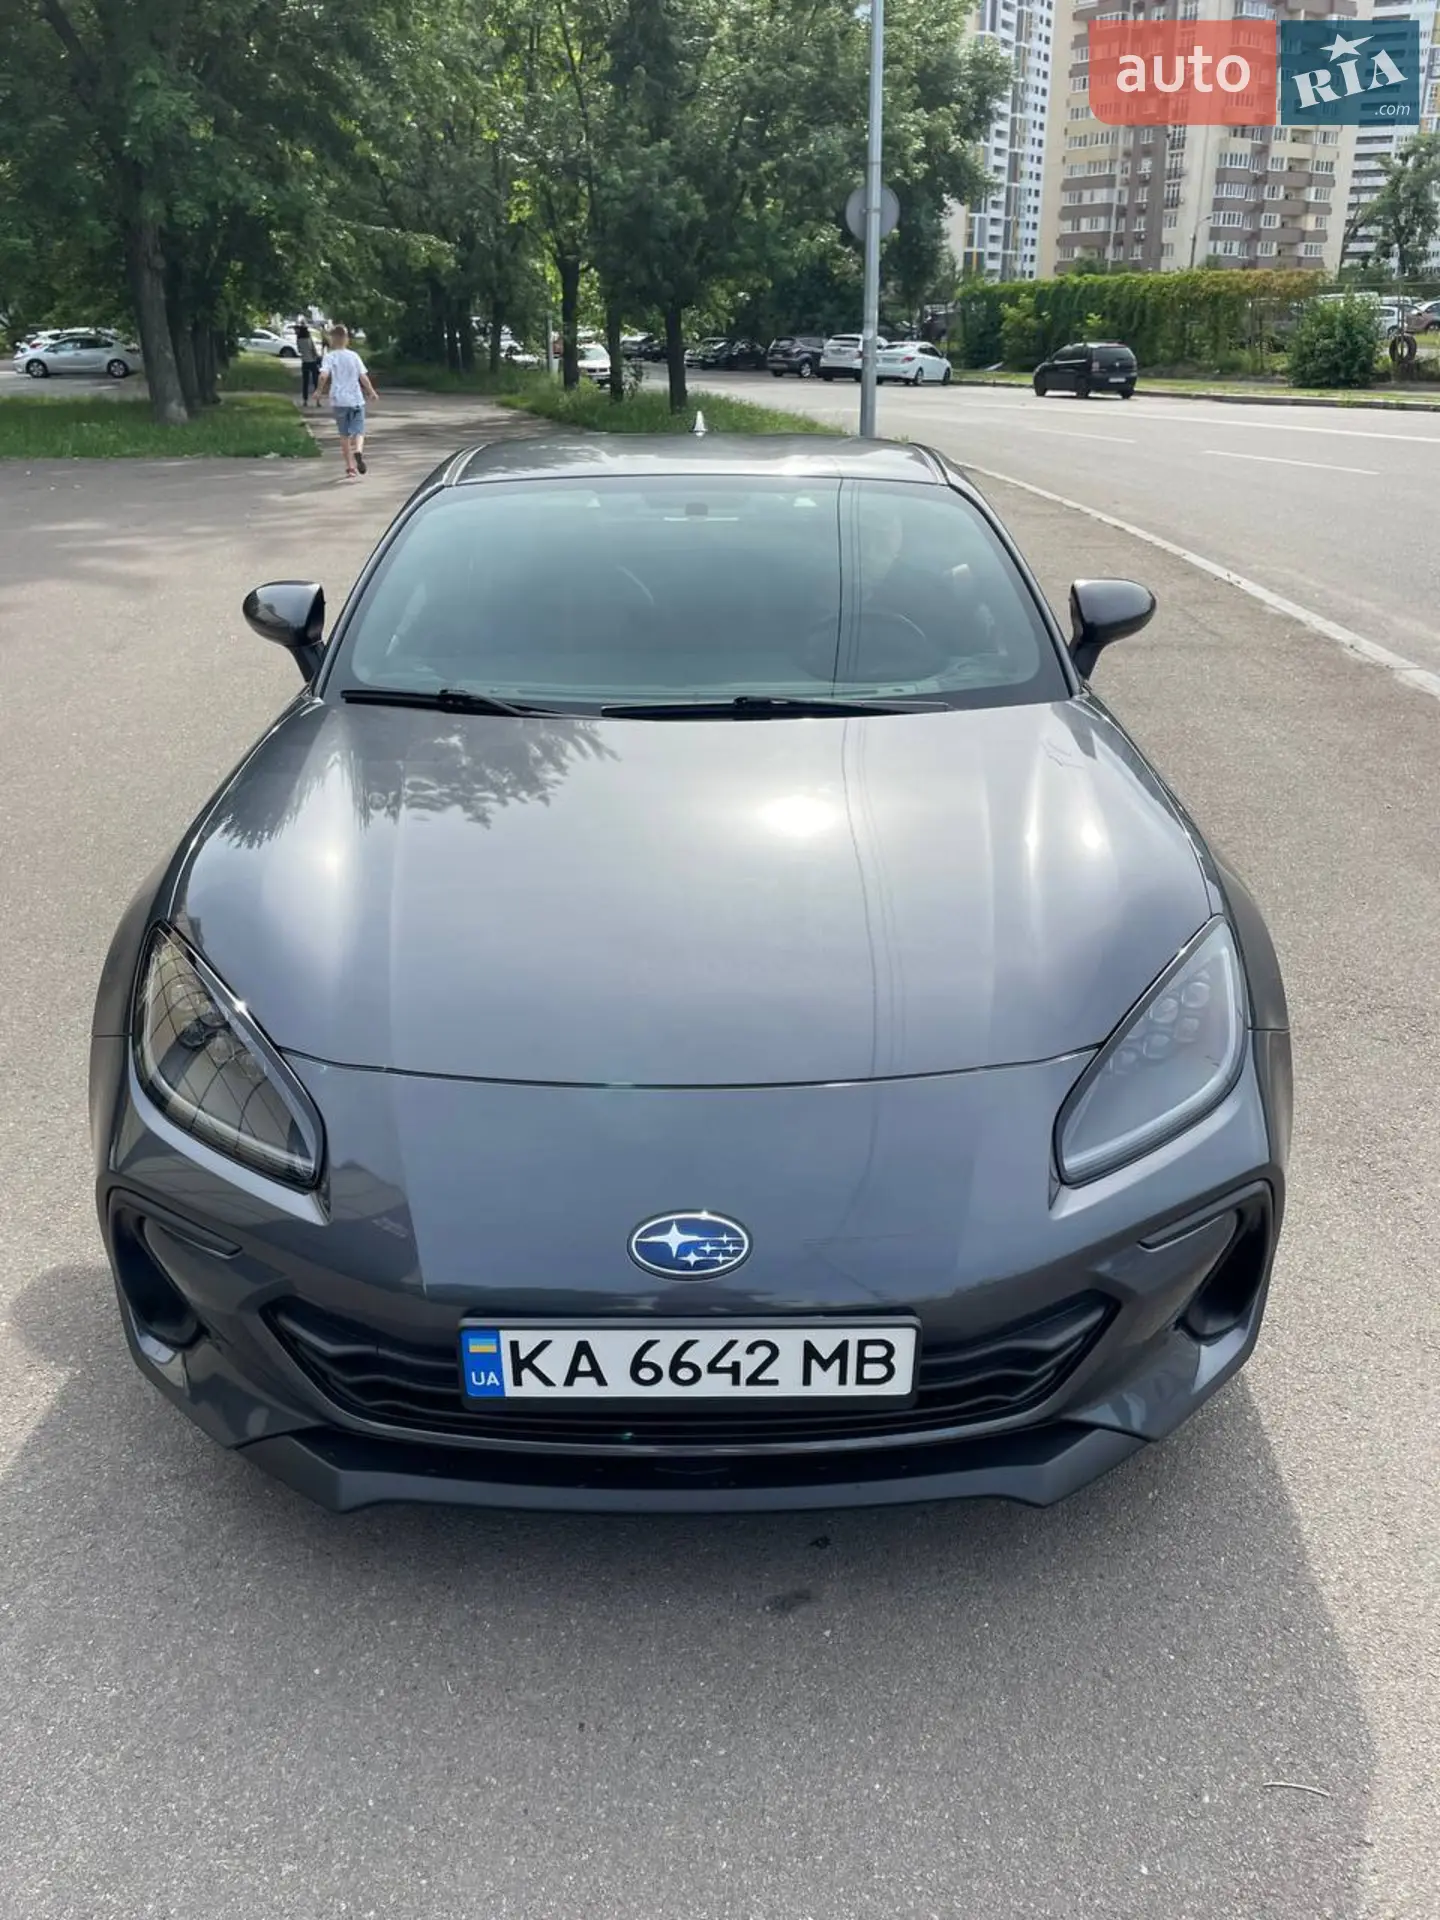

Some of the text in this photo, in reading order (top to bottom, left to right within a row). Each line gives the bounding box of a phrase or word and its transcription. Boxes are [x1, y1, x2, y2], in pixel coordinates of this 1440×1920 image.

[472, 1371, 500, 1387] UA
[509, 1339, 896, 1387] KA 6642 MB
